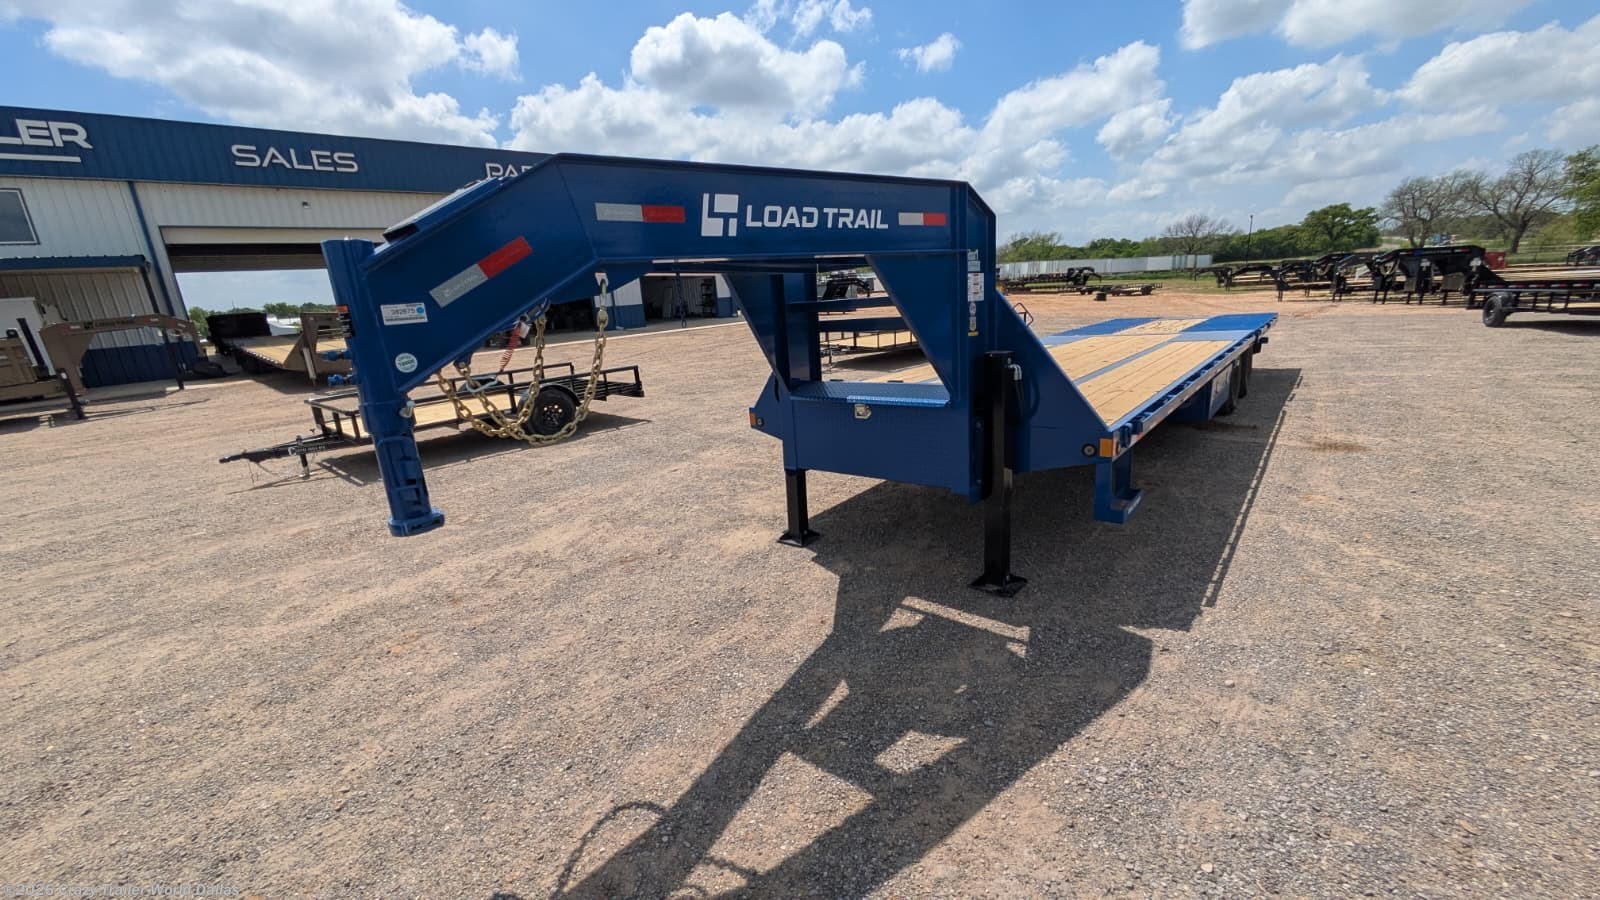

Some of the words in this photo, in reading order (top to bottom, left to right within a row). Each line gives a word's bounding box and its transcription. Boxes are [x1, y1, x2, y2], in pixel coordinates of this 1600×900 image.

[231, 144, 359, 172] SALES
[485, 163, 533, 178] PA
[746, 205, 819, 228] LOAD
[823, 207, 889, 229] TRAIL
